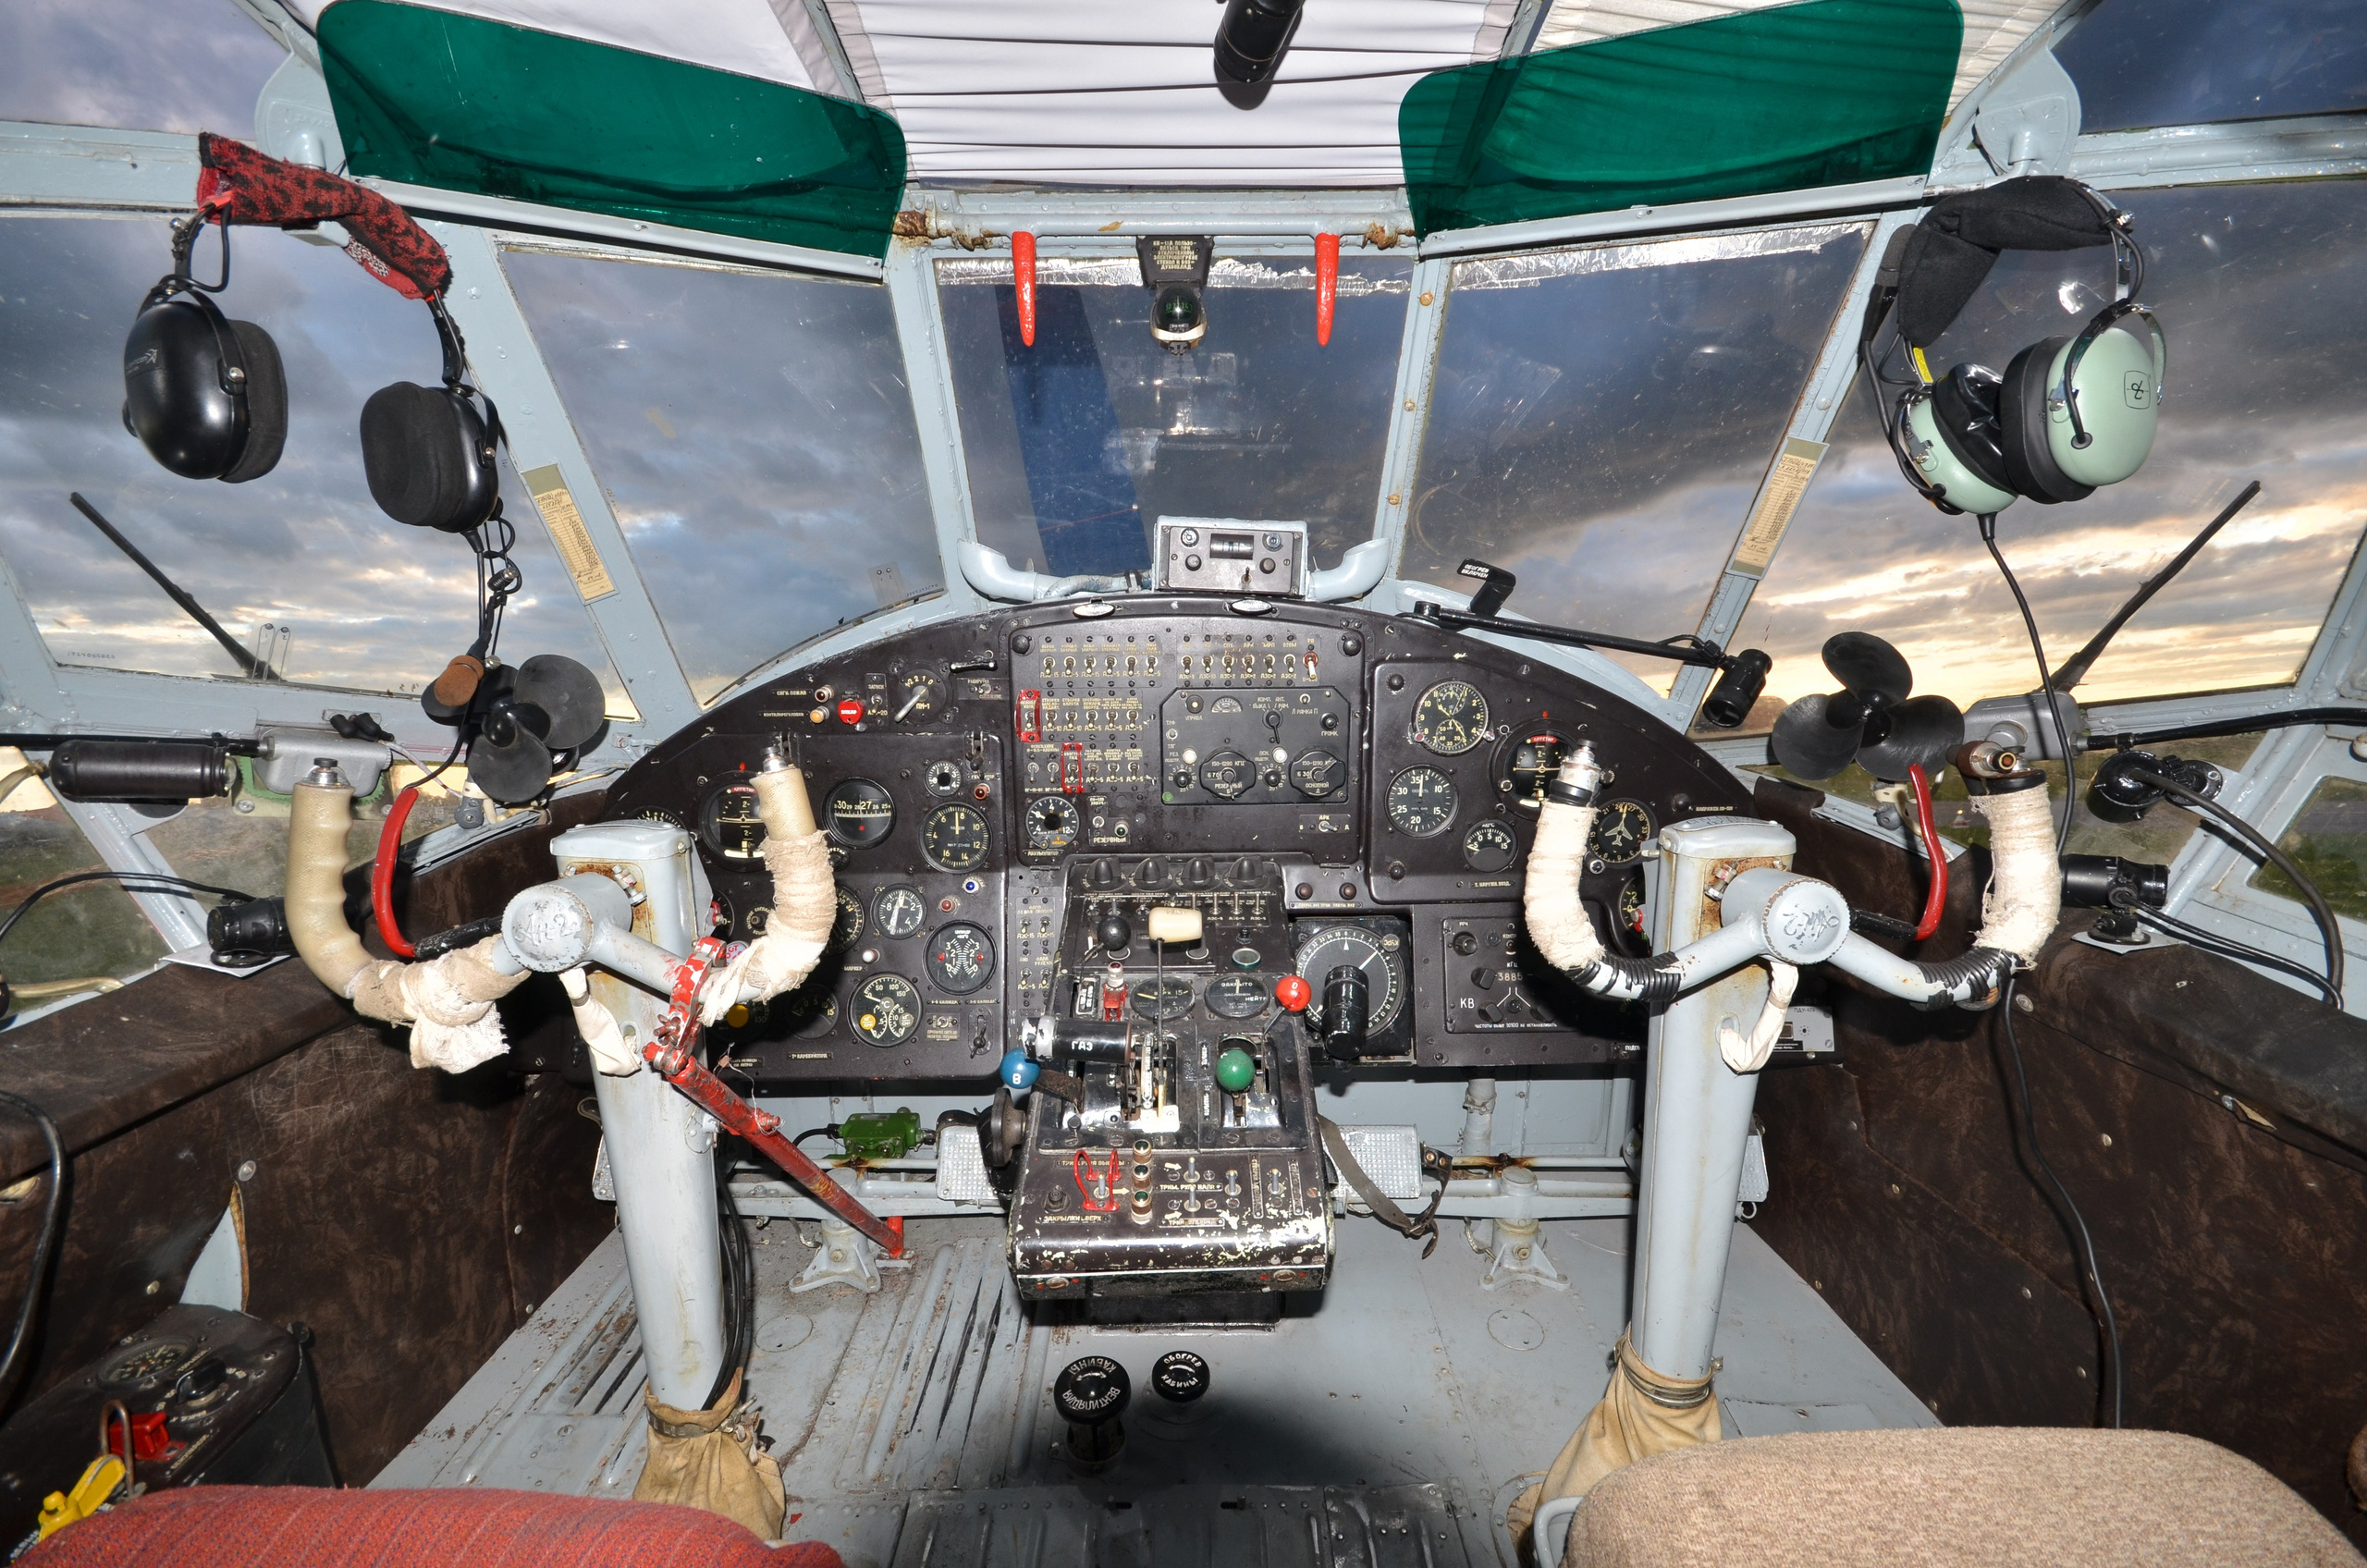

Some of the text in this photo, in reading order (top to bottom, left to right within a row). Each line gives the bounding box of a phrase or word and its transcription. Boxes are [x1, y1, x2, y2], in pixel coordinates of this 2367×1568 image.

[1397, 787, 1408, 795] 30
[1434, 785, 1442, 793] 10
[837, 801, 847, 809] 30
[861, 802, 872, 810] 27
[1397, 805, 1407, 814] 25
[1410, 815, 1421, 824] 20
[1637, 814, 1645, 822] 30
[886, 902, 892, 912] 8
[910, 902, 916, 911] 2
[904, 917, 911, 925] 4
[946, 942, 951, 950] 3
[1498, 972, 1524, 981] 3885
[1460, 998, 1475, 1009] КВ
[1071, 1040, 1094, 1051] ГАЗ
[1163, 1353, 1202, 1367] ОБОГРЕВ
[1067, 1357, 1117, 1376] КАБИНЫ
[1160, 1374, 1199, 1388] КАБИНЫ
[1062, 1386, 1121, 1411] ВЕНТИЛЯЦИЯ
